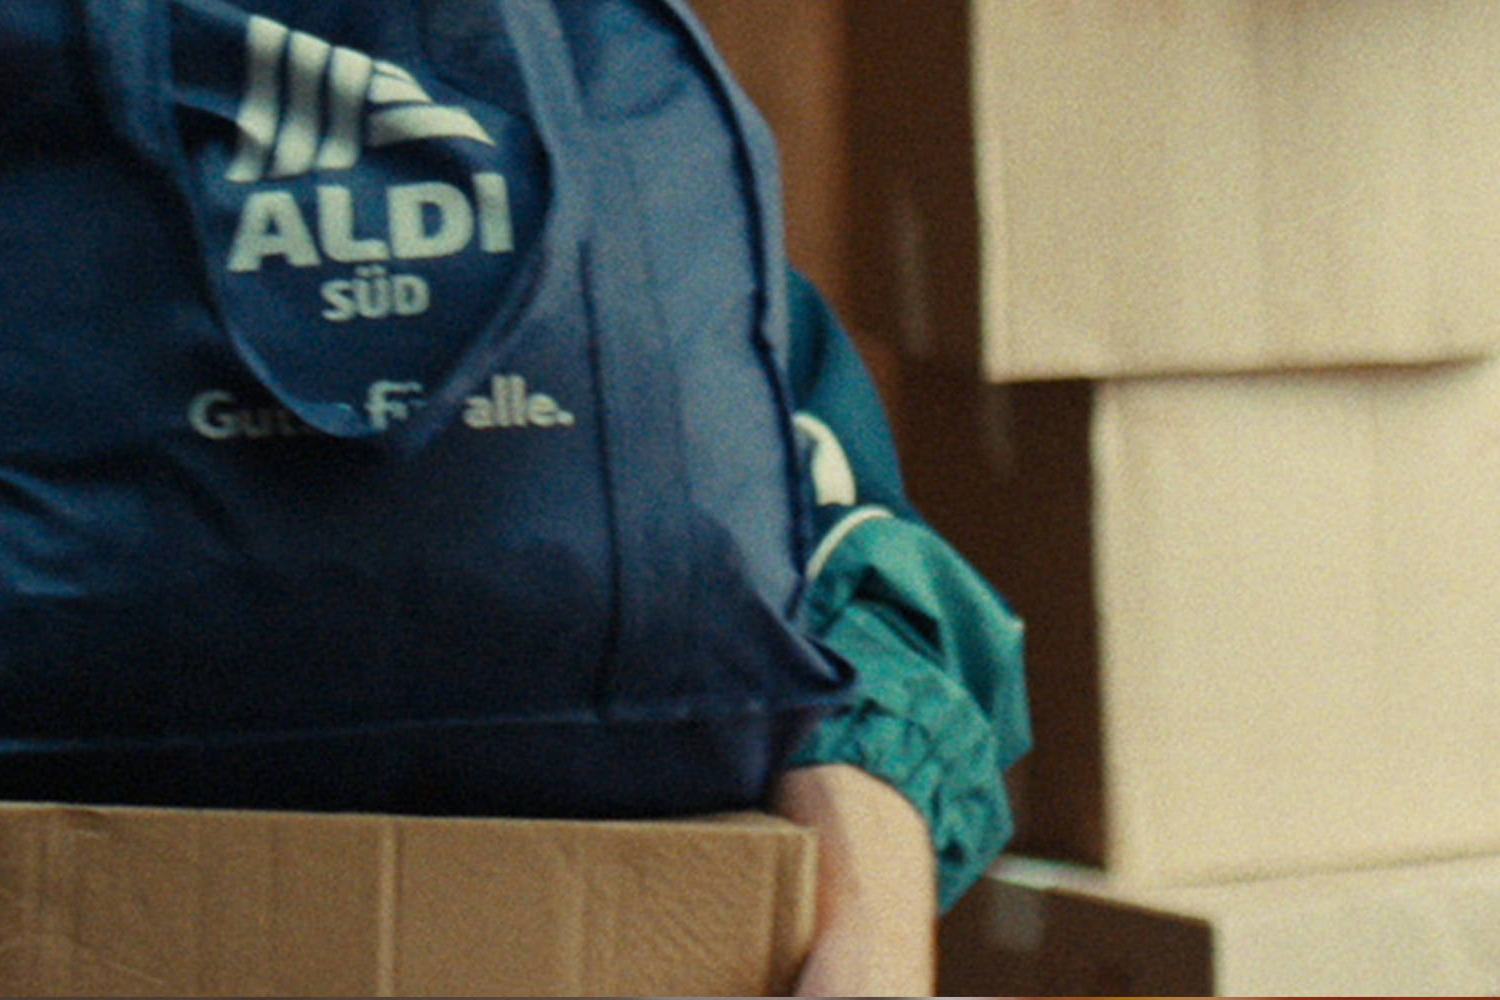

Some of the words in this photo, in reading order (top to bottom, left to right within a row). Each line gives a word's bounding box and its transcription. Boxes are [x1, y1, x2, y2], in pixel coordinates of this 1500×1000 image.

[227, 172, 515, 273] ALDI
[320, 264, 431, 322] SÜD
[462, 373, 576, 430] alle.
